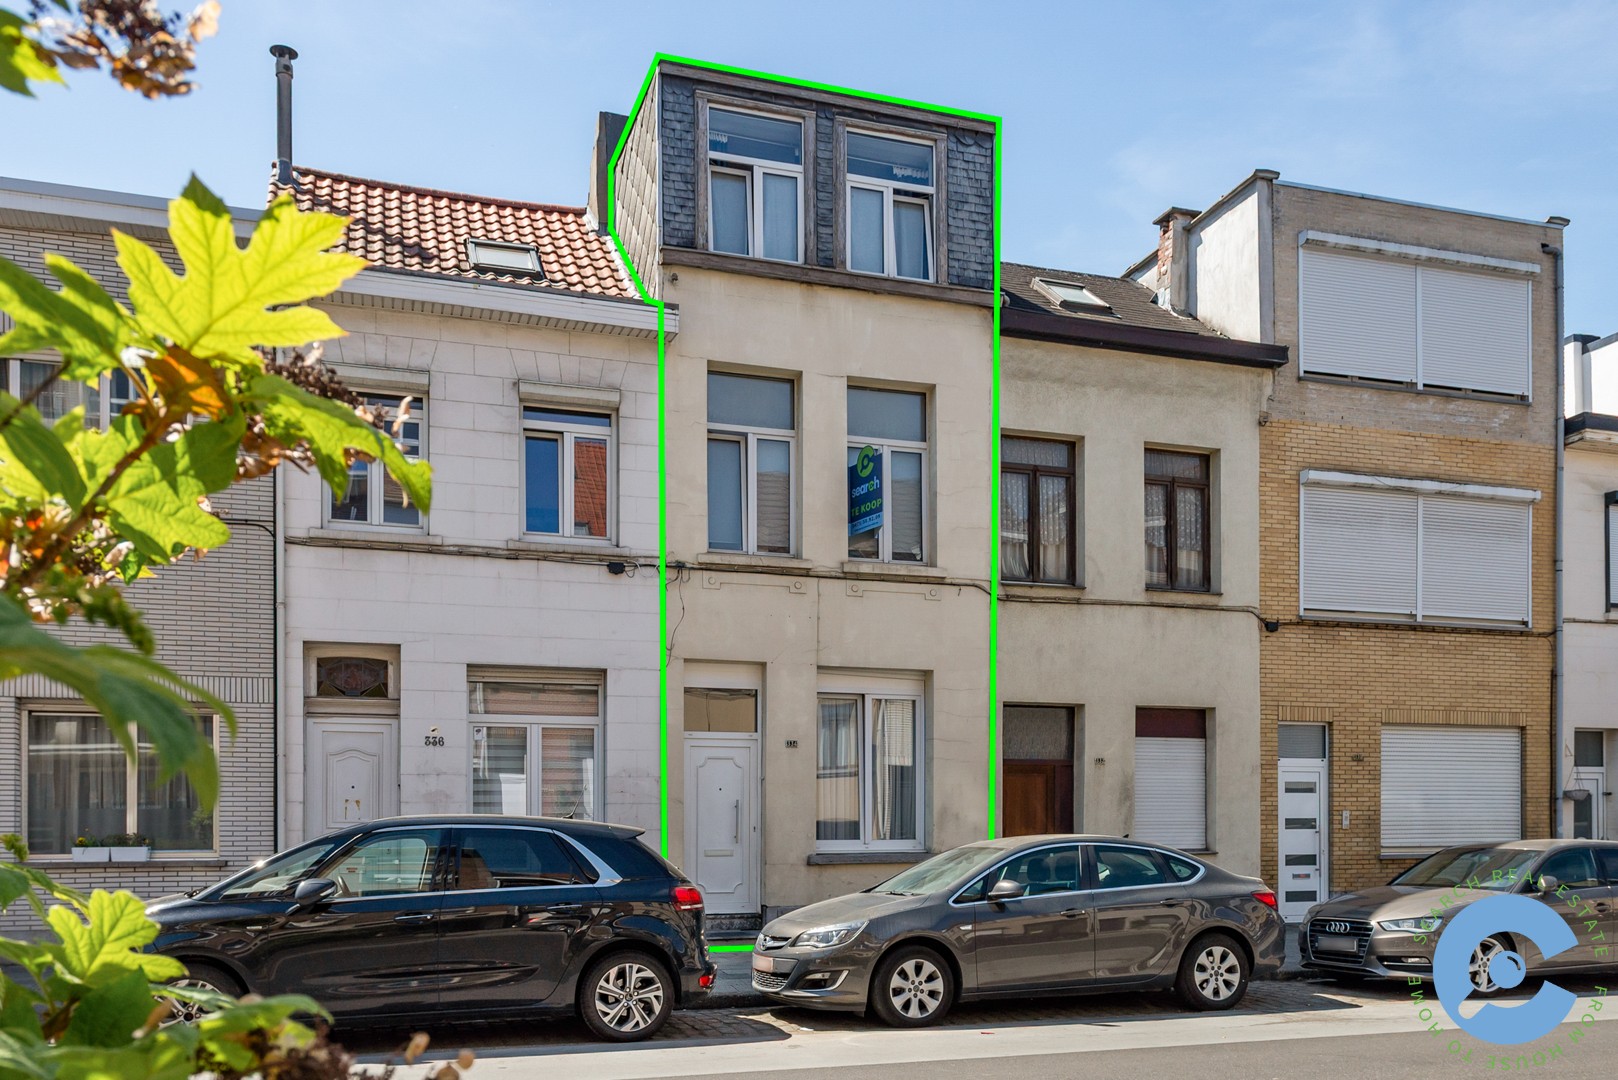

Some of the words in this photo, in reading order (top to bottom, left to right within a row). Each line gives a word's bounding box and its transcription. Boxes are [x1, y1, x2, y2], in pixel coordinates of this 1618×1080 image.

[851, 476, 880, 498] search
[851, 507, 860, 517] TE
[861, 498, 882, 513] KOOP
